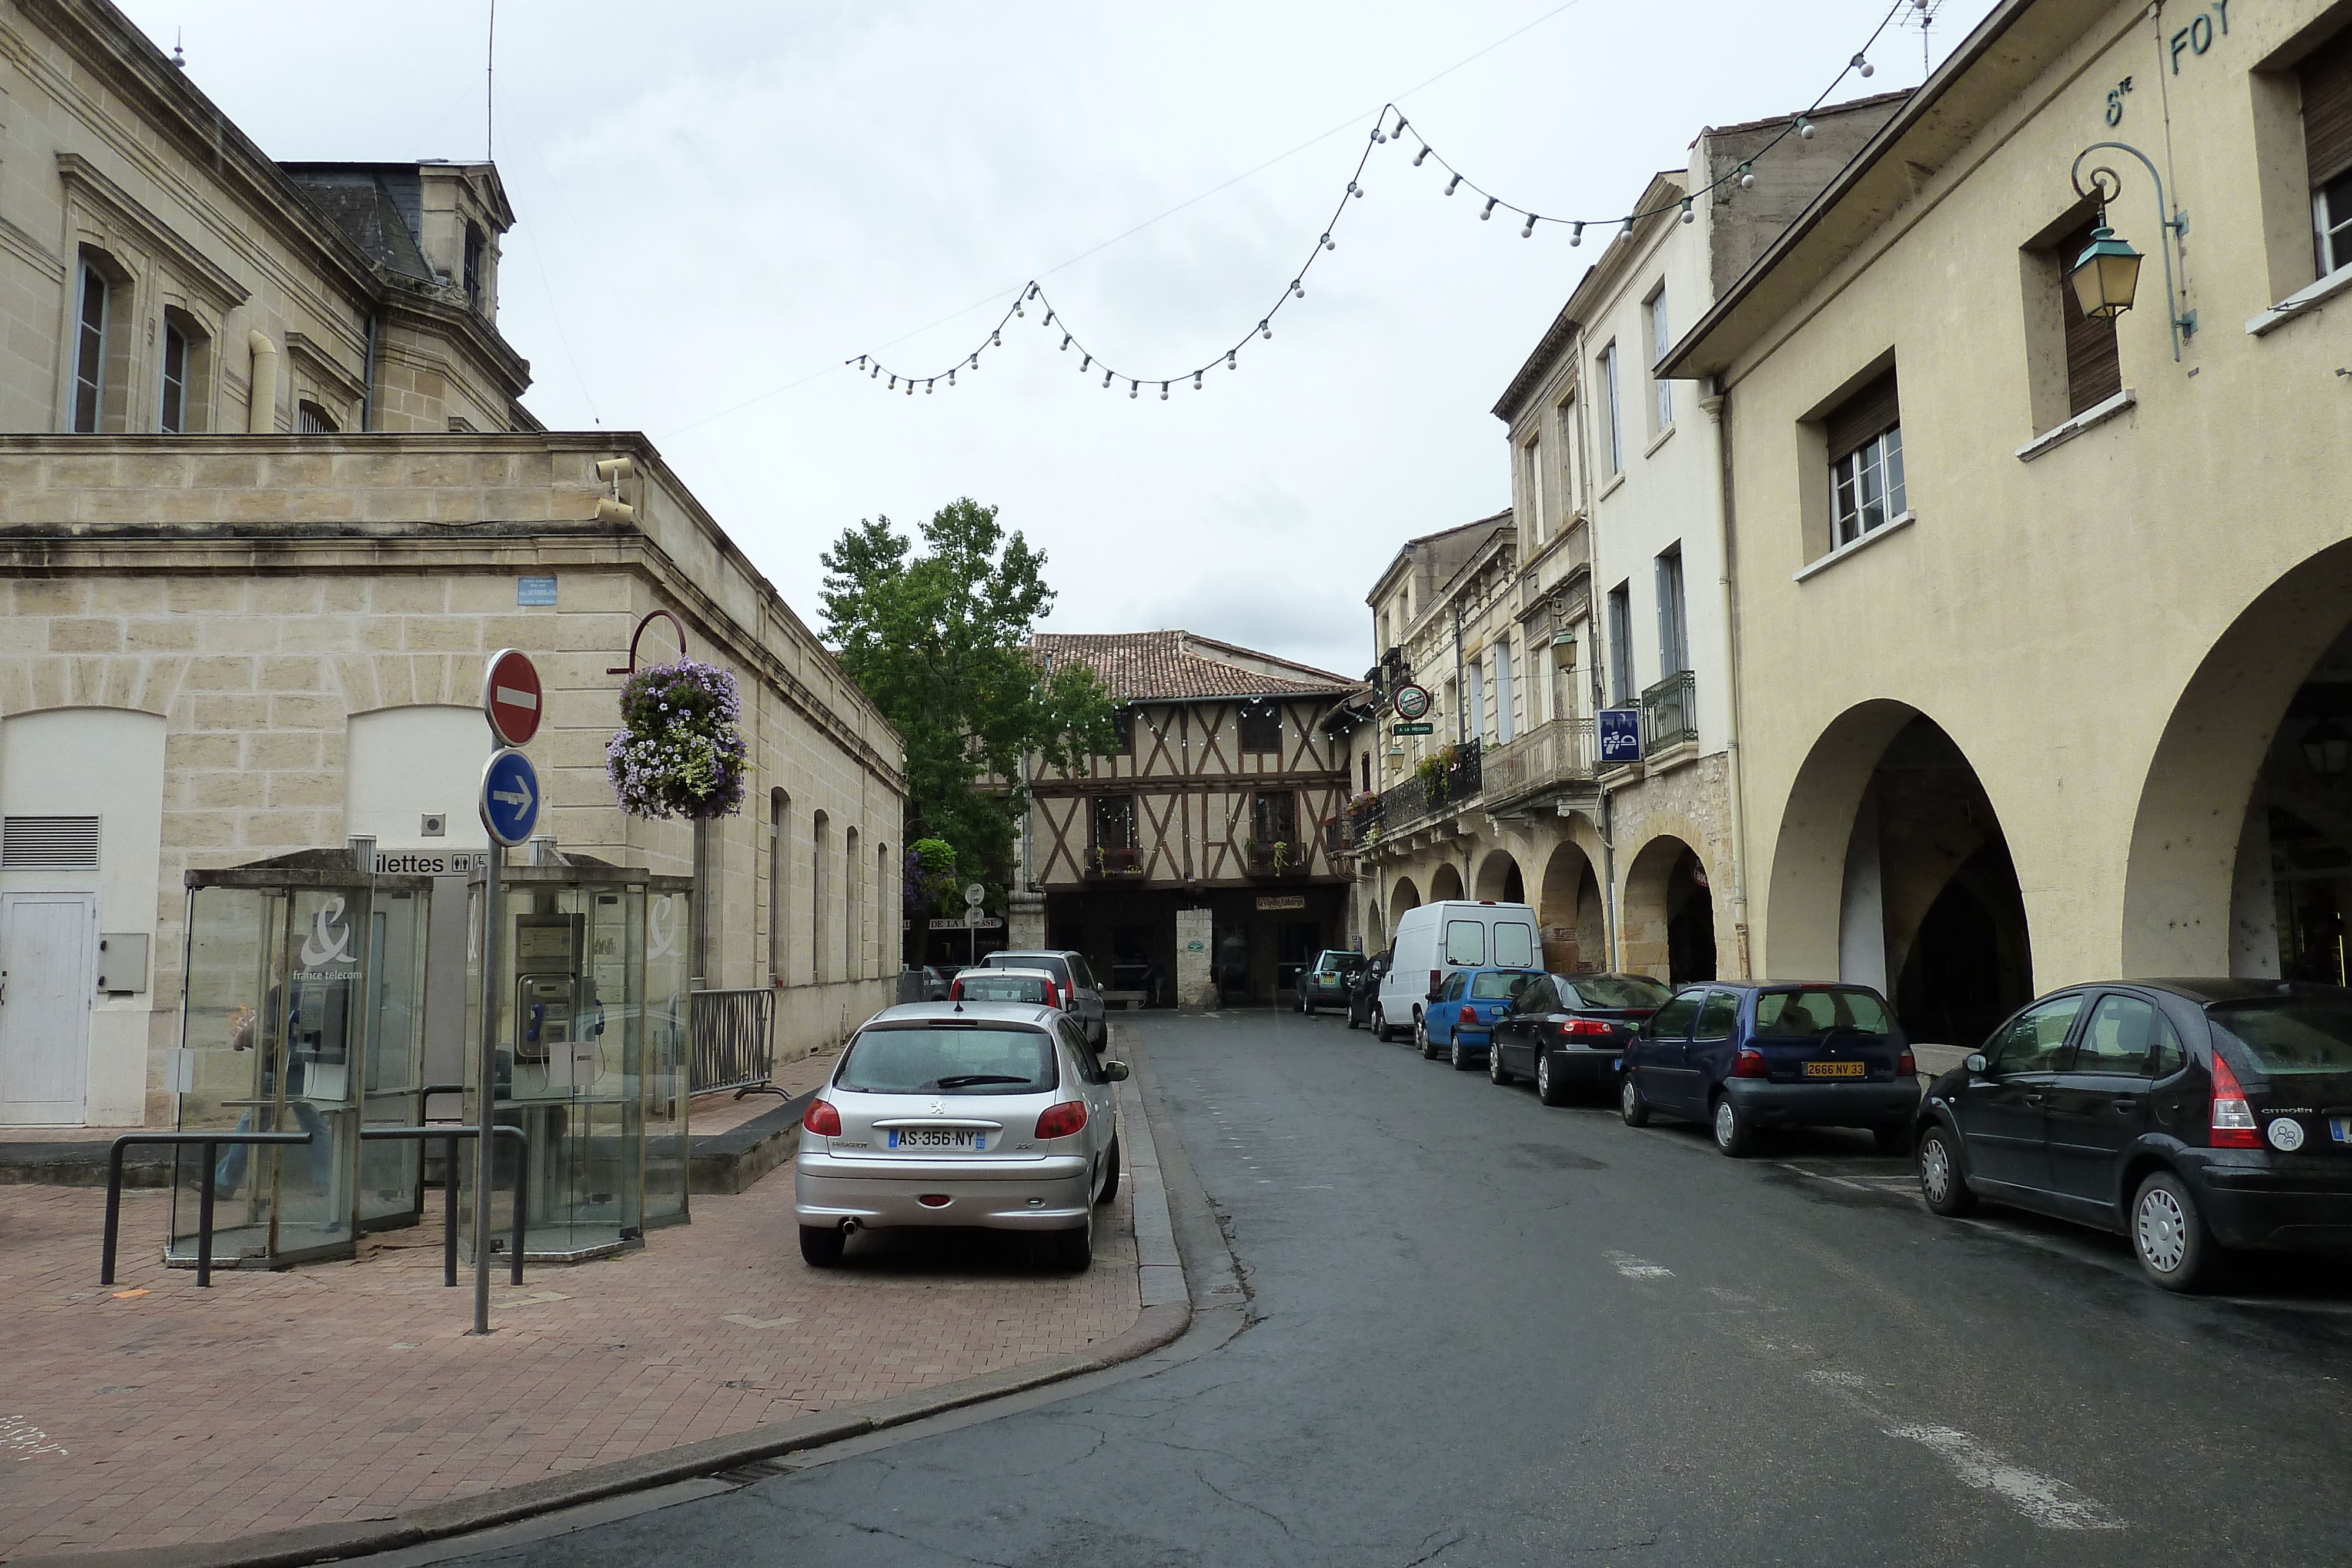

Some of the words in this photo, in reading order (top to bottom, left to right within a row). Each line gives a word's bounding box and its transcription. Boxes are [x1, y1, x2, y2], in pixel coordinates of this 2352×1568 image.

[2170, 0, 2227, 75] FOY
[376, 854, 444, 872] ilettes
[293, 971, 322, 980] france
[325, 971, 362, 979] telecom
[1808, 1065, 1833, 1074] 2666
[1836, 1065, 1848, 1074] NV
[1851, 1064, 1863, 1074] 33
[898, 1131, 975, 1145] AS-356-NY
